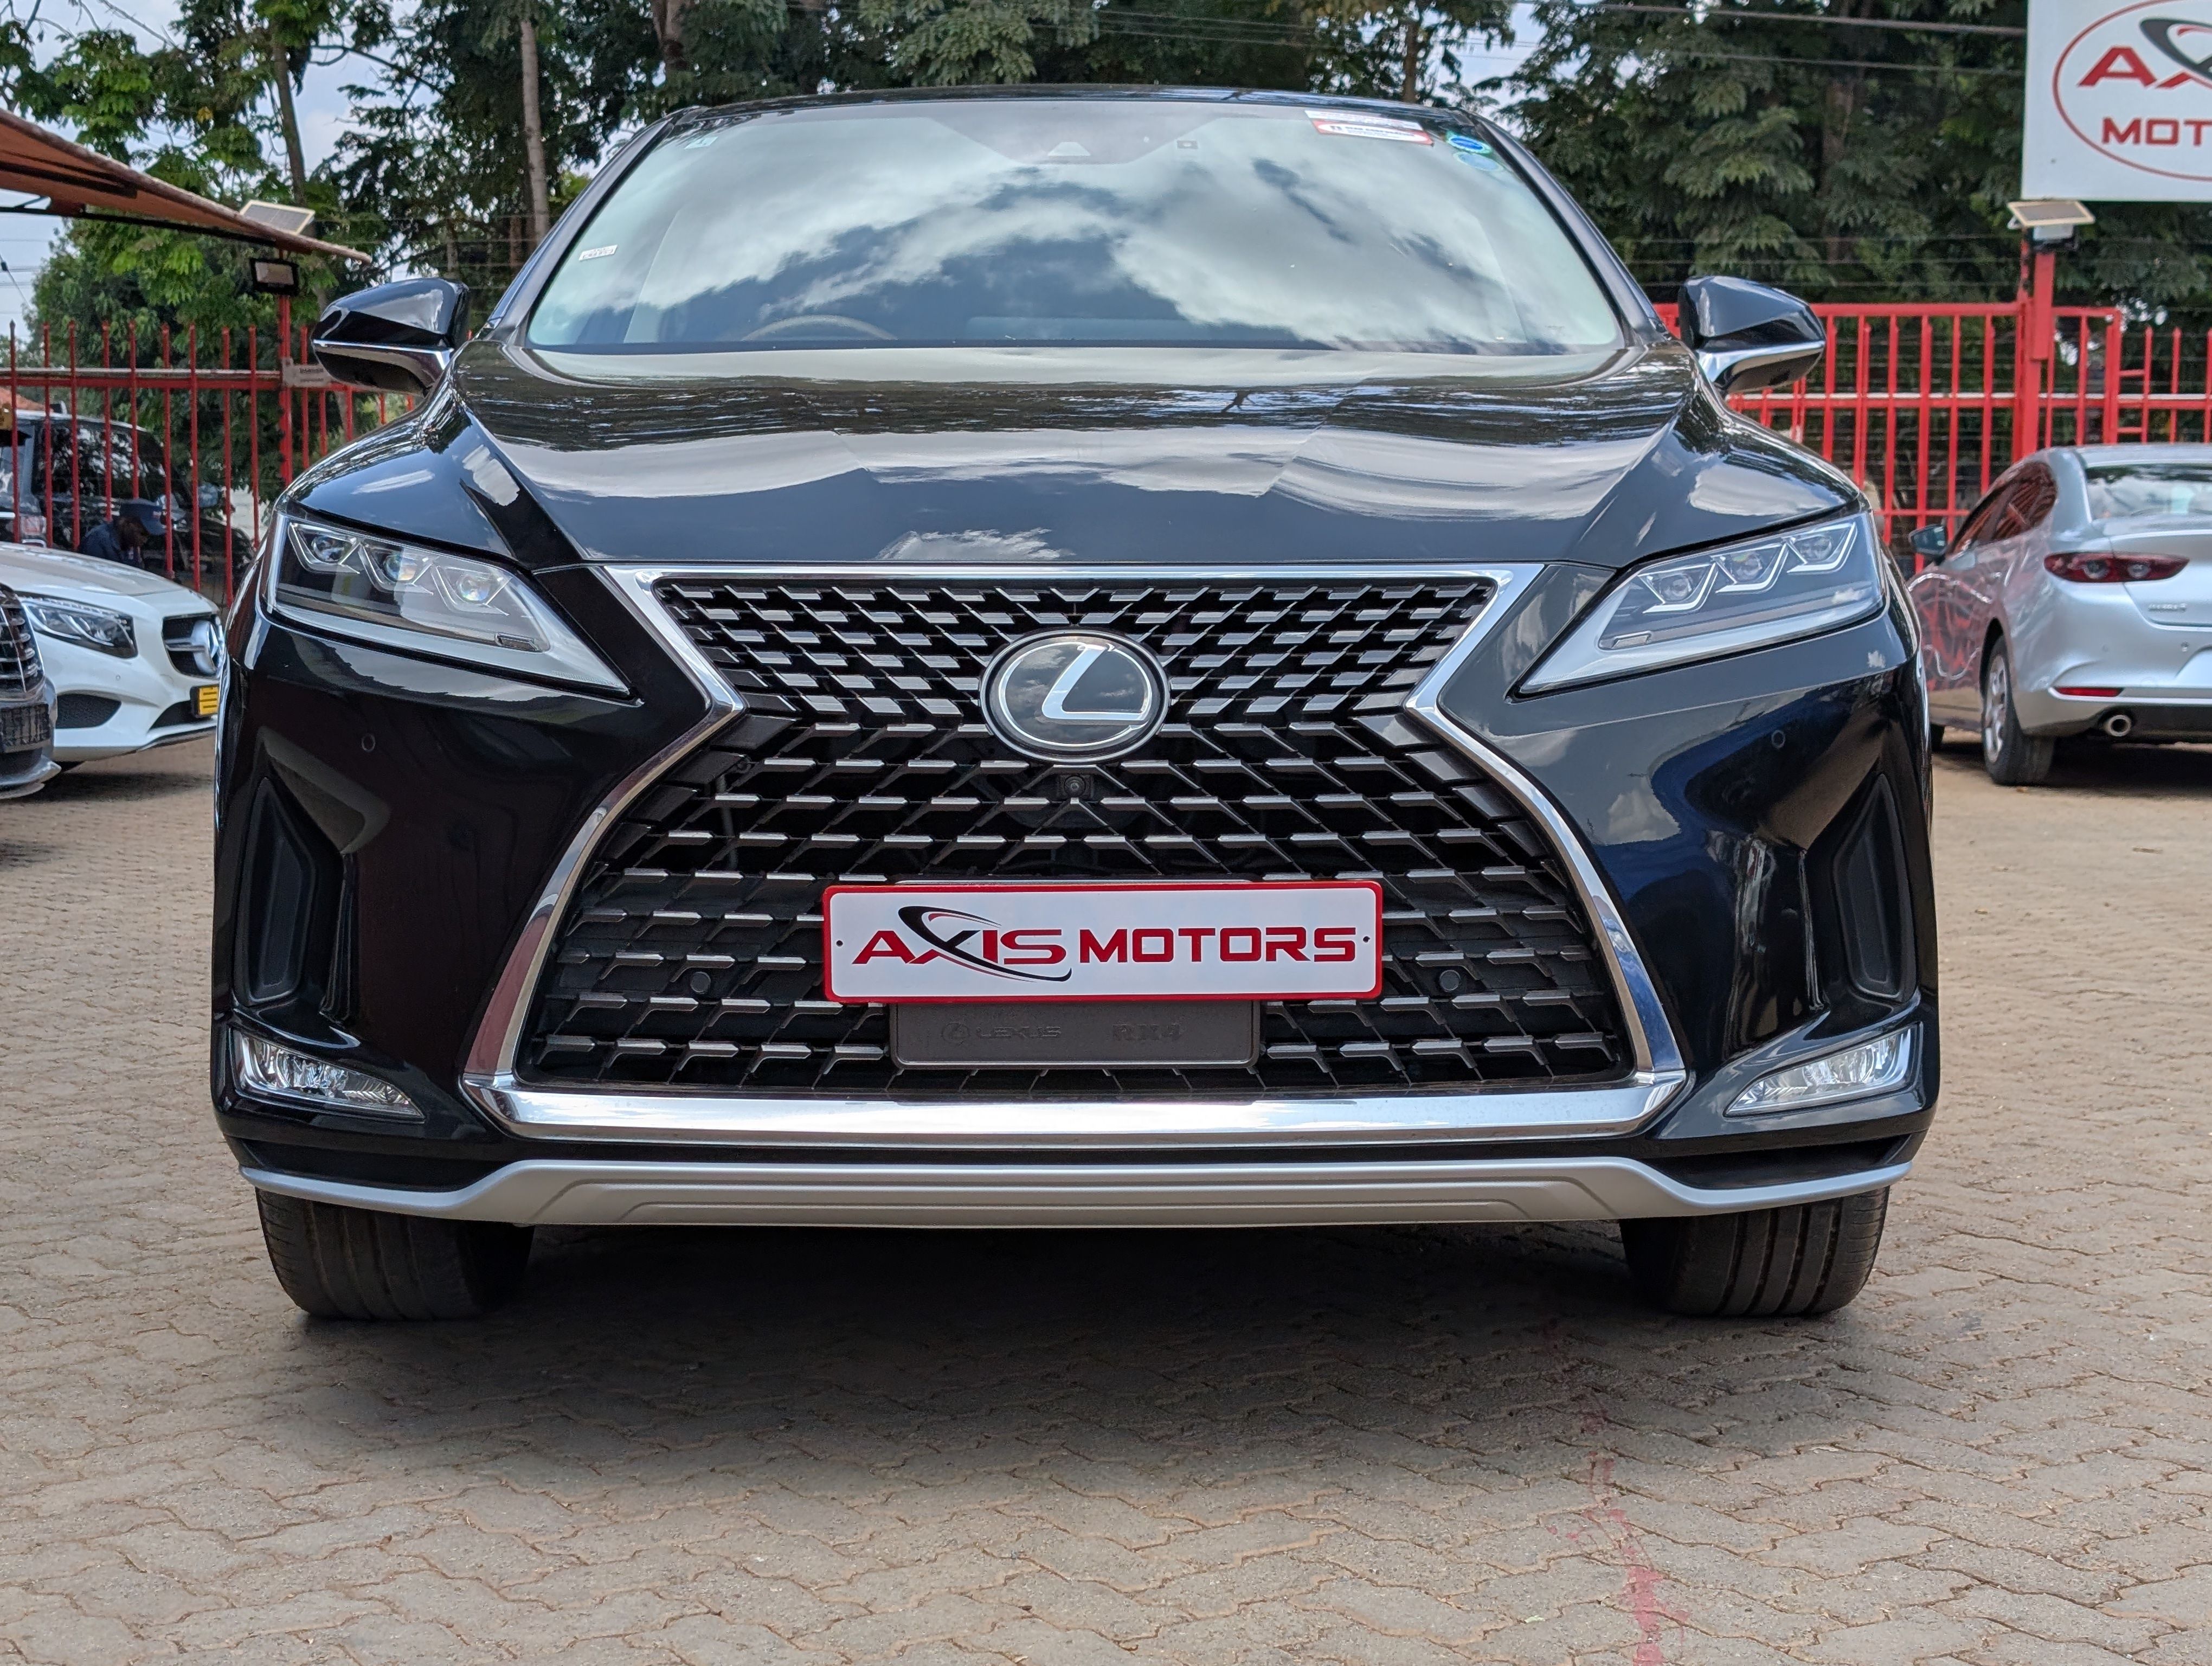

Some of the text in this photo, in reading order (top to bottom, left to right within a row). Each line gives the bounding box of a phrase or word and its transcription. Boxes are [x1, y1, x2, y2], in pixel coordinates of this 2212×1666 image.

[852, 911, 1356, 973] AXIS MOTORS
[975, 1025, 1062, 1040] LEXUS
